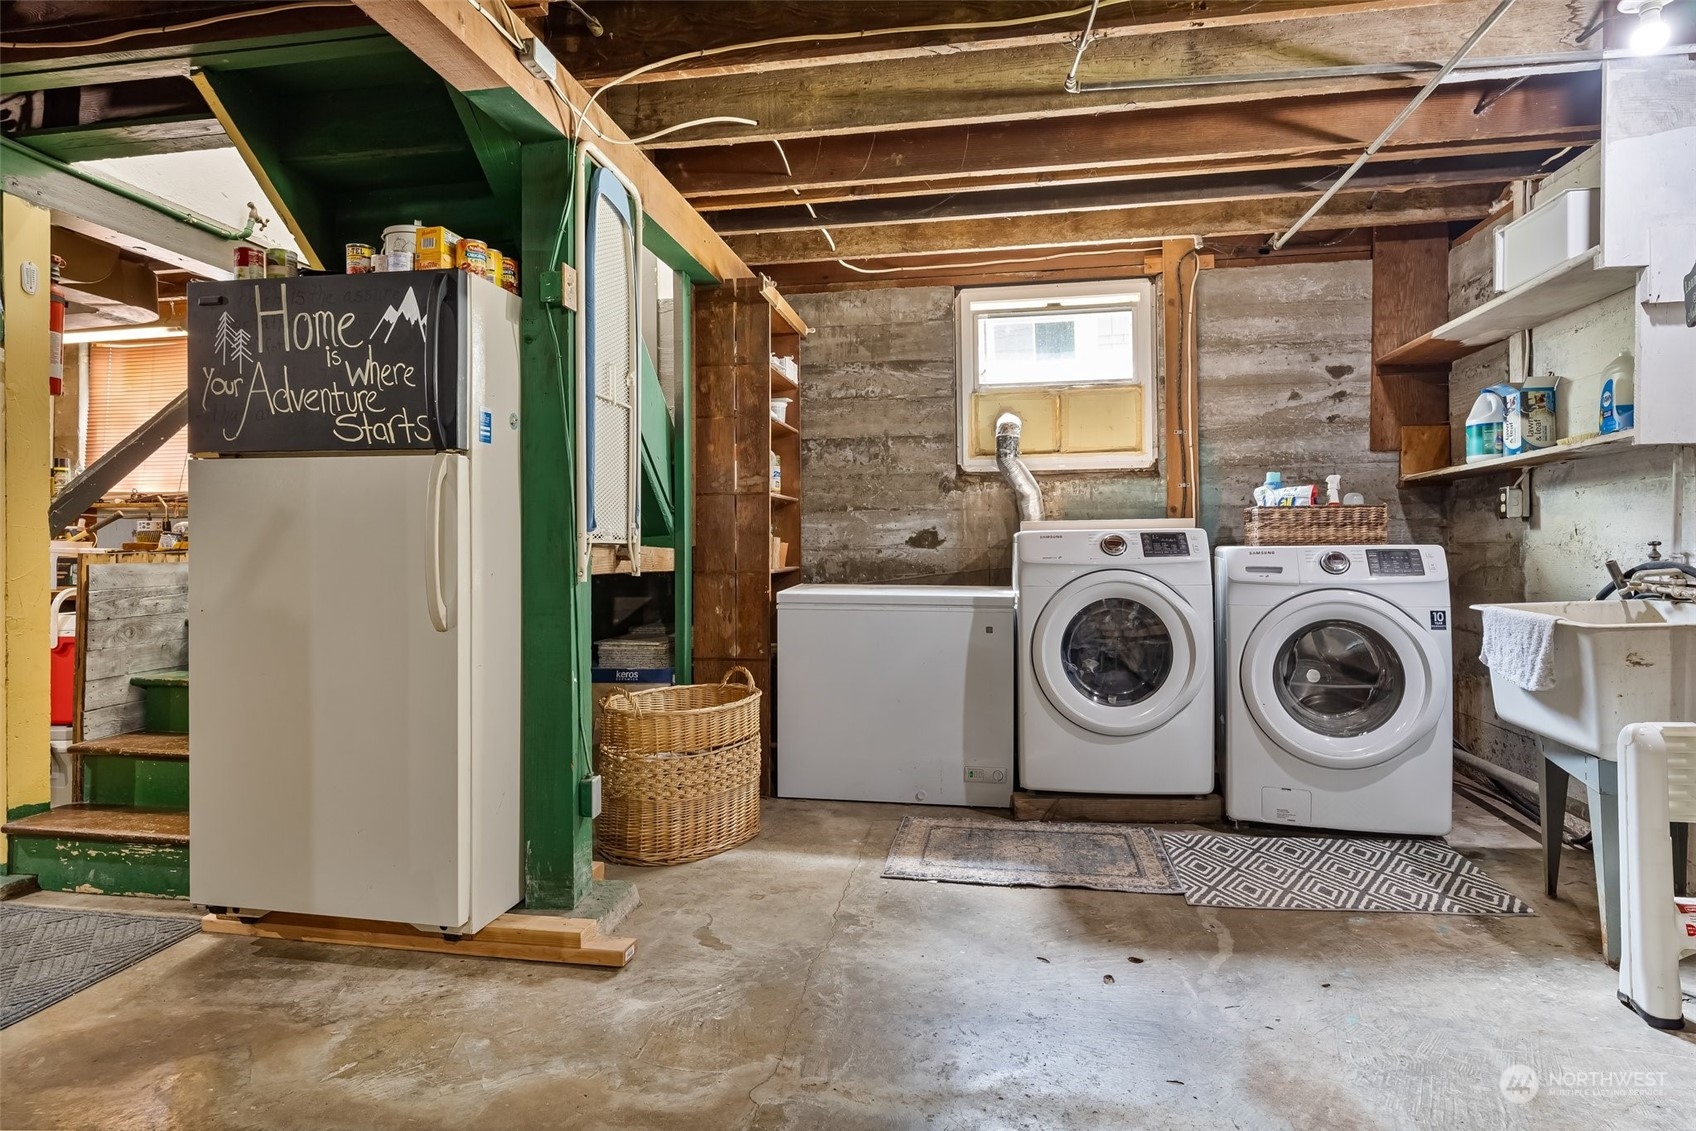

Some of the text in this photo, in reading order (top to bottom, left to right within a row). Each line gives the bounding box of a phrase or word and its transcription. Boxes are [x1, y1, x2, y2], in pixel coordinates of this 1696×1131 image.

[255, 283, 363, 353] Home
[325, 346, 342, 367] is
[345, 345, 416, 391] where
[223, 361, 386, 441] Adventure
[333, 408, 431, 444] Starts
[1534, 419, 1542, 435] leaf
[1431, 611, 1444, 622] 10
[616, 670, 639, 679] keros
